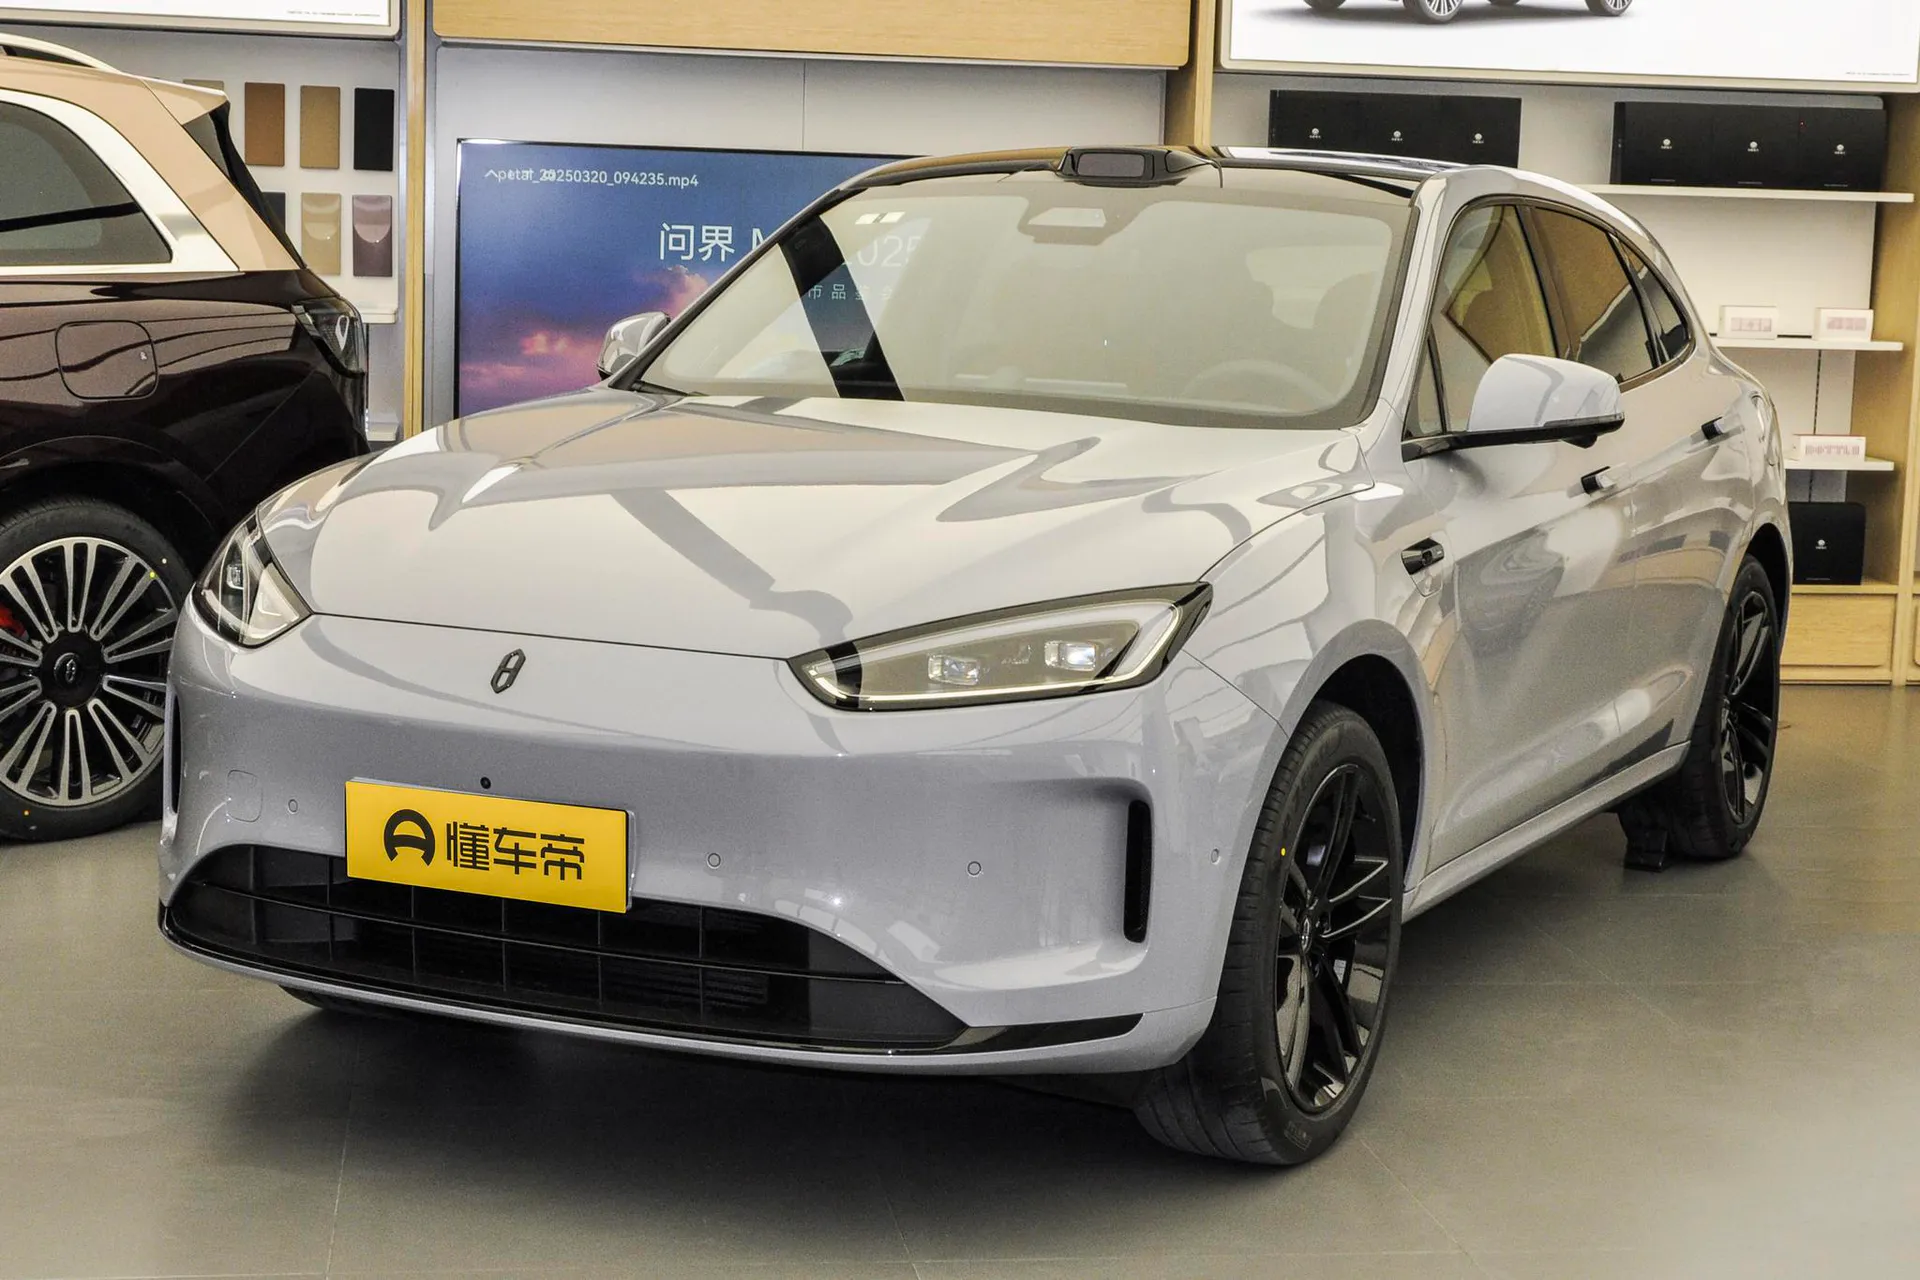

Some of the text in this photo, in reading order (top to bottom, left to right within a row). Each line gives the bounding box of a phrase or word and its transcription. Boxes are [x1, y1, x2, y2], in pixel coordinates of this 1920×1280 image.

[659, 222, 736, 262] 问界
[446, 821, 585, 881] 懂车帝
